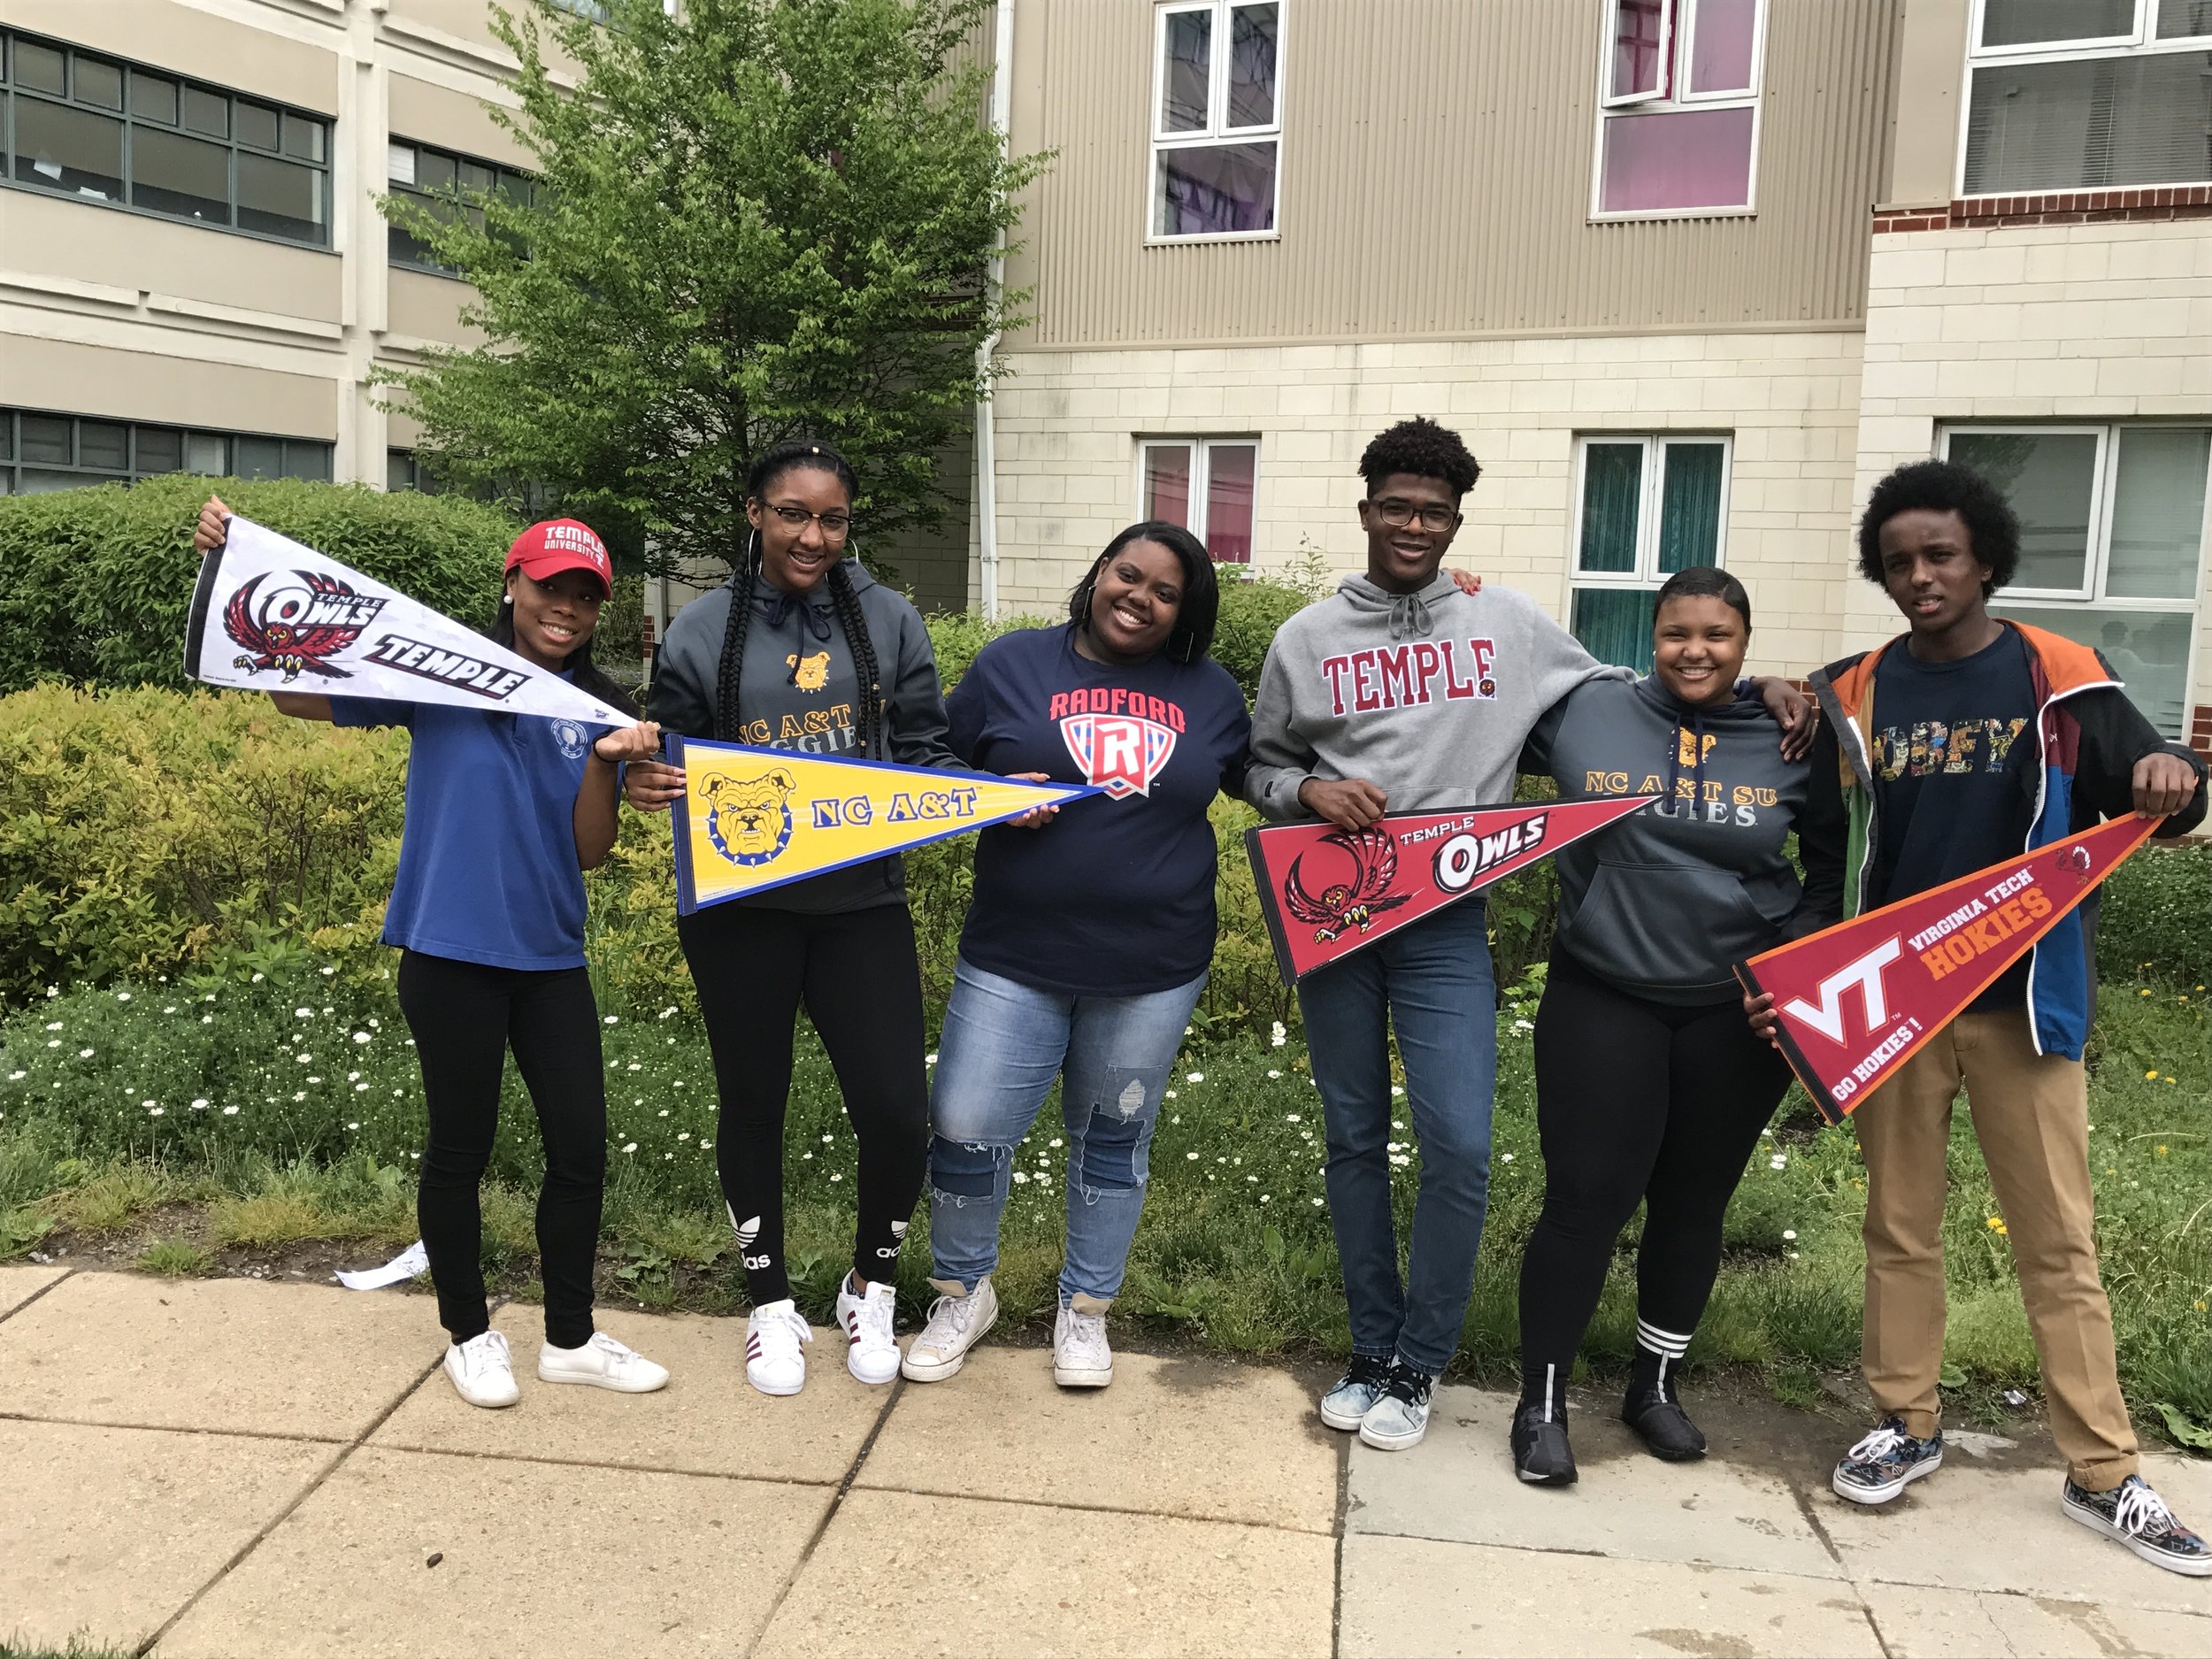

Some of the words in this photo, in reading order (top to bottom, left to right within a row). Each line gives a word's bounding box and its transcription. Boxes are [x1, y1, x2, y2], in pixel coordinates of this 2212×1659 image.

[543, 538, 594, 560] UNIVERSITY
[545, 526, 604, 555] TEMPLE
[264, 588, 379, 626] OWLS
[317, 593, 383, 608] TEMPLE
[372, 634, 528, 697] TEMPLE
[780, 703, 851, 739] A&T
[1049, 687, 1187, 733] RADFORD
[1095, 721, 1141, 776] R
[1872, 718, 2029, 781] OBEY
[811, 795, 873, 829] NC
[887, 787, 978, 823] A&T
[1586, 771, 1629, 793] NC
[1732, 786, 1778, 807] SU
[1400, 816, 1475, 847] TEMPLE
[1434, 812, 1548, 890] OWLS
[1908, 898, 1989, 952] VIRGINIA
[1984, 867, 2035, 904] TECH
[1919, 887, 2053, 981] HOKIES
[1778, 933, 1904, 1048] VT
[1832, 1076, 1857, 1102] GO
